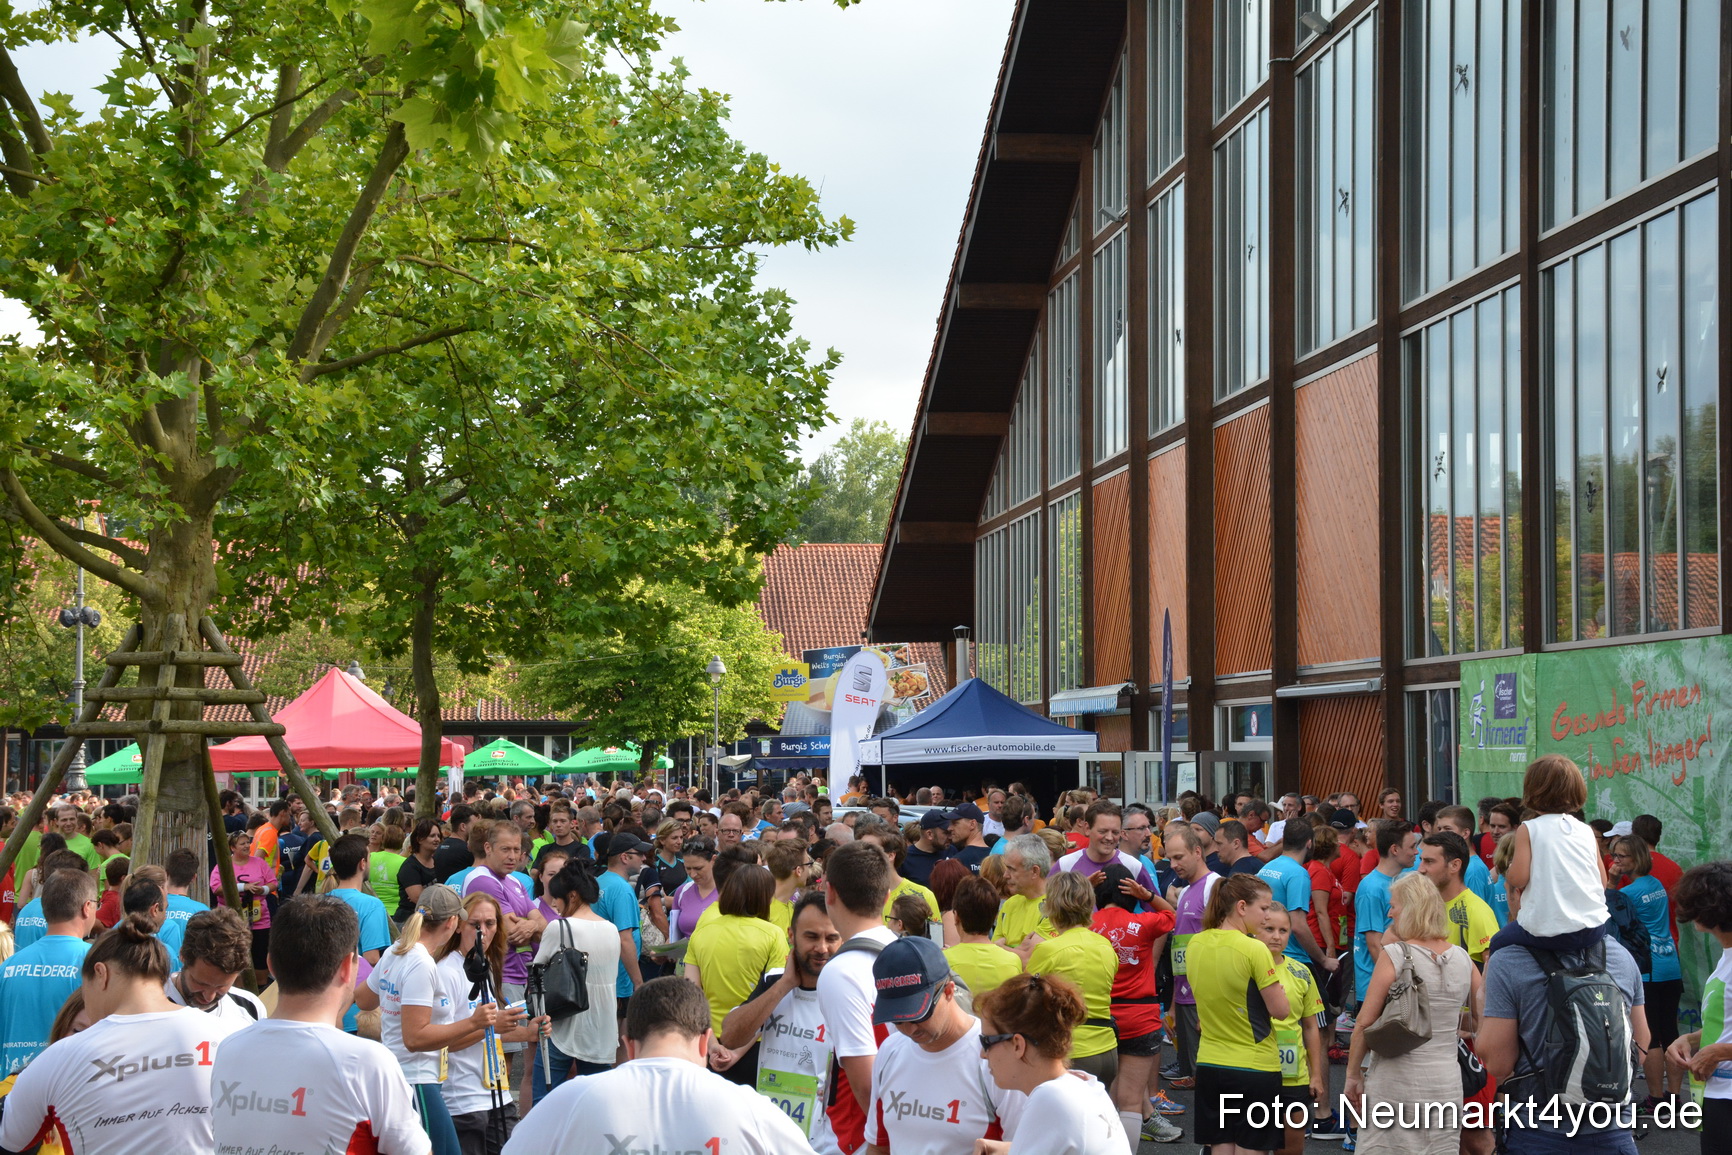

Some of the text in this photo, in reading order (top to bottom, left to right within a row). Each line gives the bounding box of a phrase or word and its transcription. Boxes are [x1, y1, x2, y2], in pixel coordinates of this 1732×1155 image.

[773, 674, 807, 688] Burgis
[845, 694, 876, 707] SEAT
[1551, 680, 1701, 741] Gesunde Firmen
[781, 743, 807, 754] Burgis
[925, 743, 1056, 754] www.fischer-automobile.de
[1589, 713, 1714, 786] laufen länger!
[894, 974, 921, 987] GREEN
[765, 1013, 826, 1043] Xplus1
[86, 1041, 212, 1083] Xplus1
[766, 1047, 798, 1059] SPORTGEIST
[216, 1080, 307, 1117] Xplus1
[885, 1090, 961, 1124] Xplus1
[94, 1103, 208, 1128] IMMER AUF ACHSE
